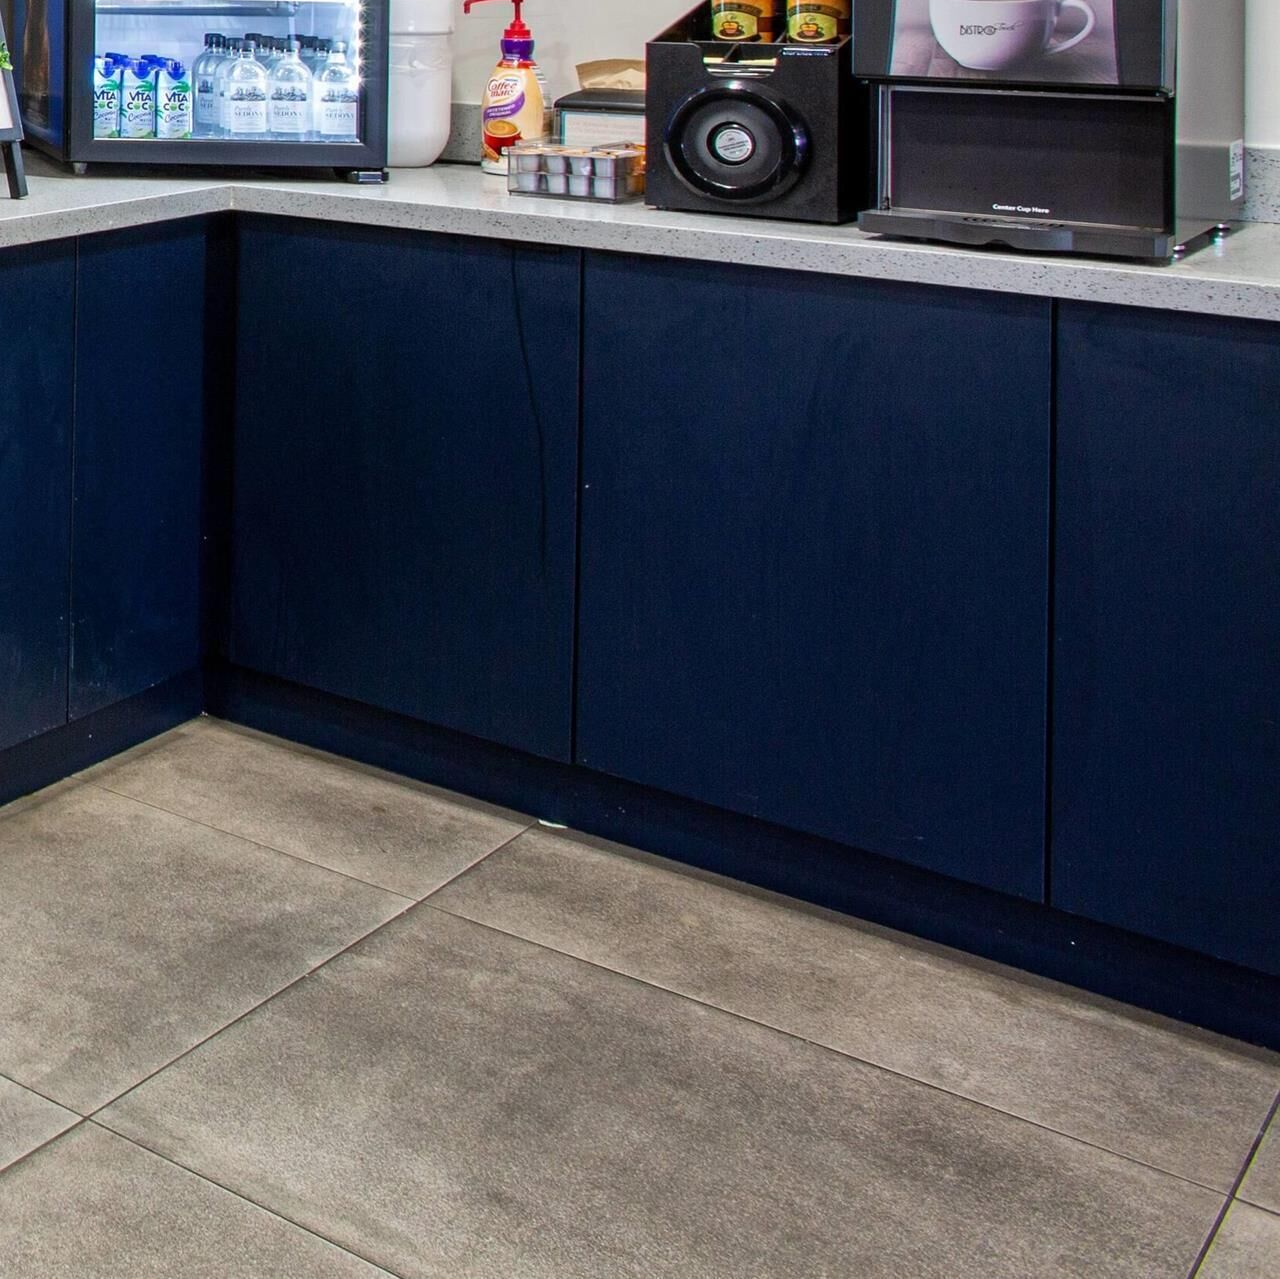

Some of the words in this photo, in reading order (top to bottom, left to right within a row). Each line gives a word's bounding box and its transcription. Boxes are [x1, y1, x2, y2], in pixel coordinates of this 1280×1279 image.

[959, 24, 996, 36] BISTRO
[487, 78, 517, 92] Coffee
[94, 90, 117, 101] VITA
[128, 90, 152, 102] VITA
[165, 91, 188, 102] VITA
[992, 203, 1016, 211] Center
[1016, 205, 1031, 213] Cup
[1031, 206, 1050, 214] Here
